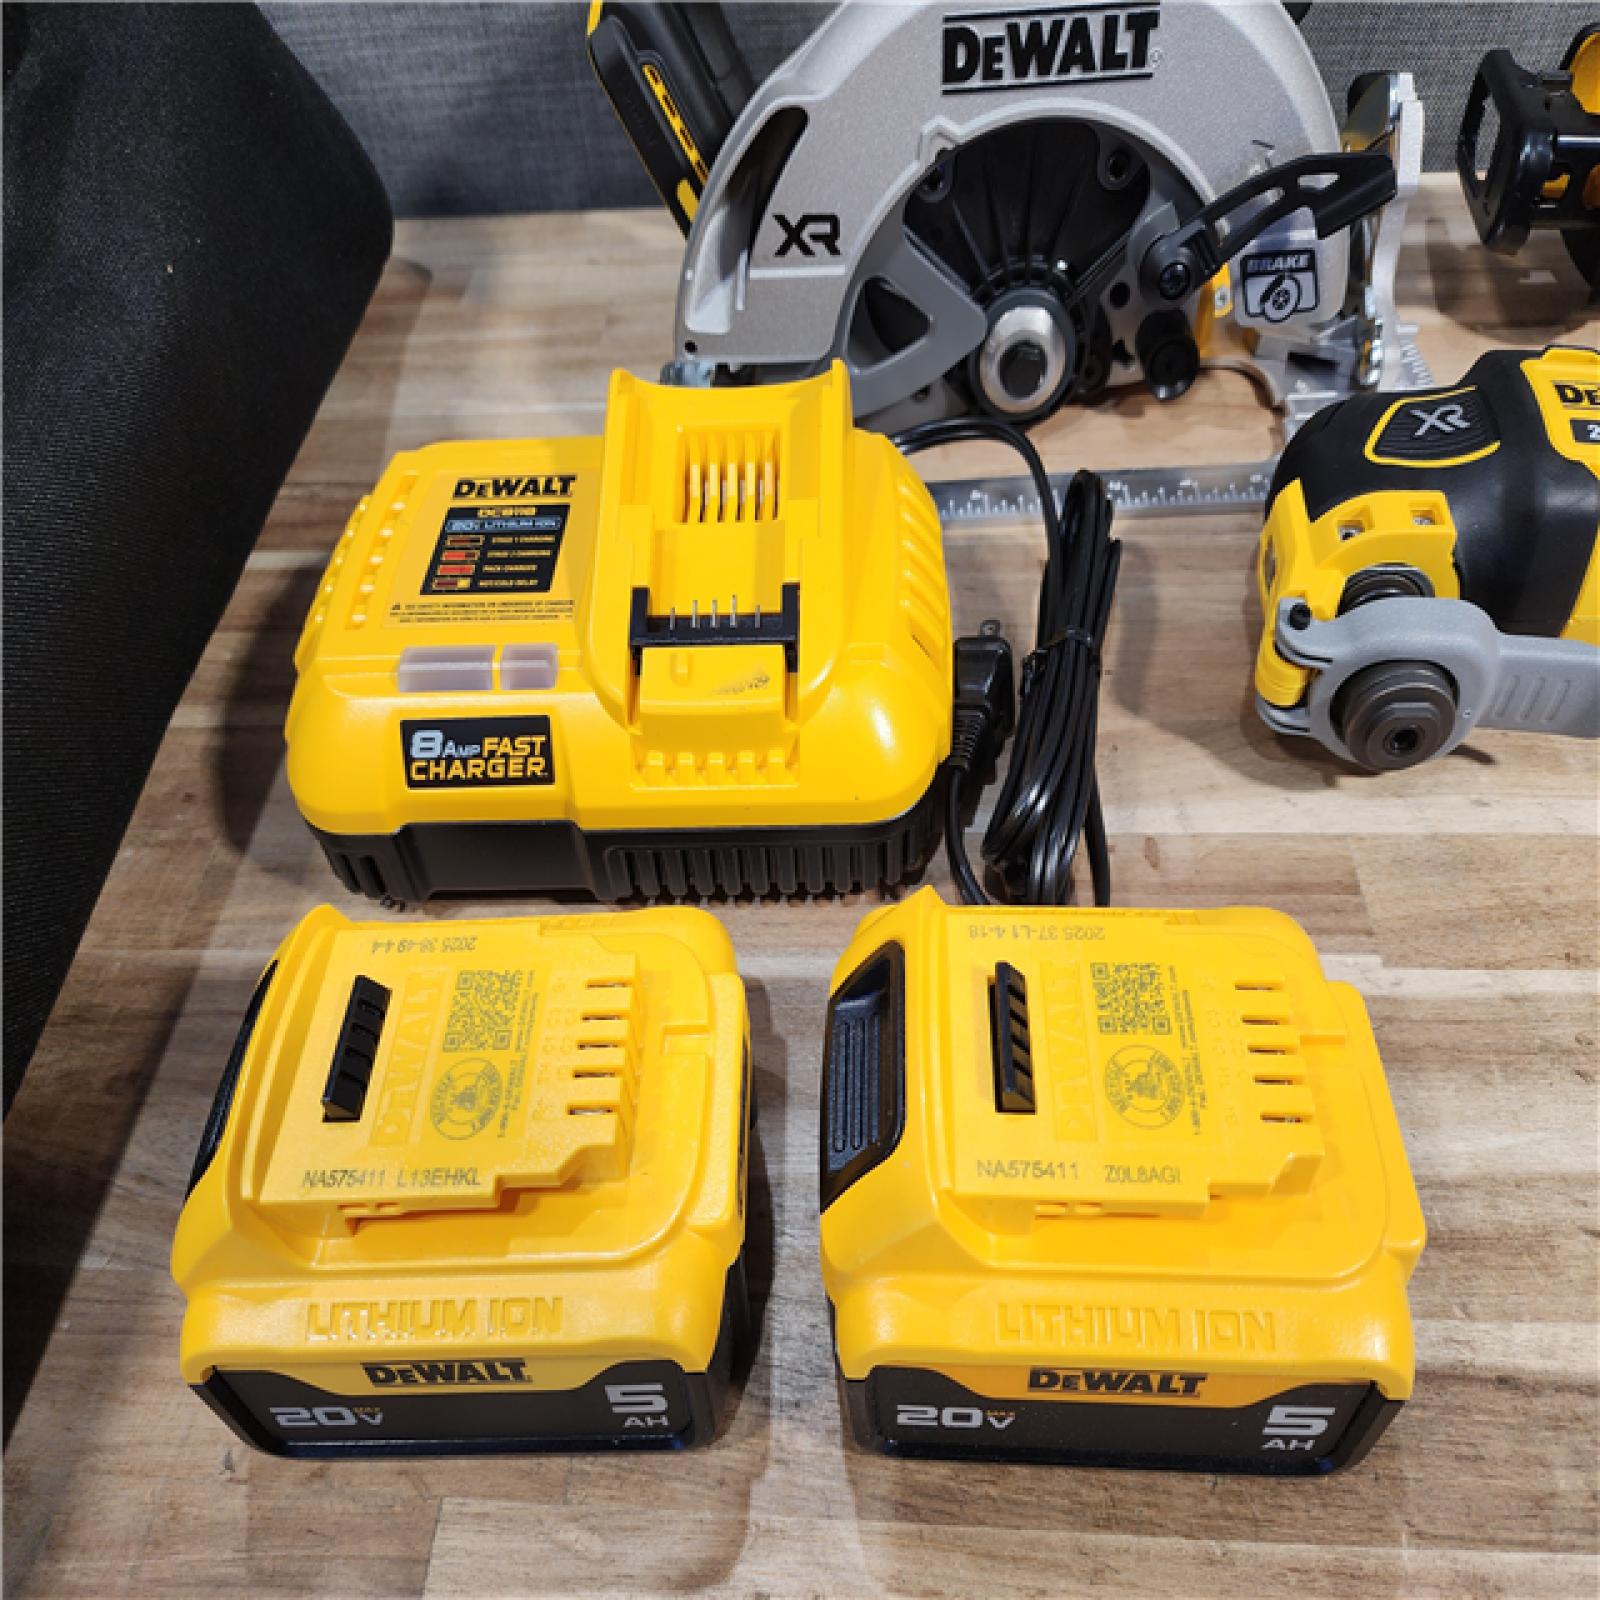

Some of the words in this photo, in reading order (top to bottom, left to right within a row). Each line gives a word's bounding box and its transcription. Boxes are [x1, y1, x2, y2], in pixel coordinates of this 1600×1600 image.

[772, 214, 841, 255] XR
[1409, 404, 1471, 437] XR
[483, 735, 546, 757] FAST
[411, 756, 546, 780] CHARGER
[1062, 926, 1106, 941] 2025
[976, 1159, 1079, 1180] NA575411
[306, 1299, 477, 1343] LITHIUM
[488, 1296, 564, 1338] ION
[996, 1302, 1180, 1348] LITHIUM
[1193, 1309, 1275, 1351] ION
[605, 1384, 668, 1413] 5
[624, 1415, 669, 1427] AH
[1262, 1406, 1336, 1435] 5
[1261, 1438, 1313, 1451] AH
